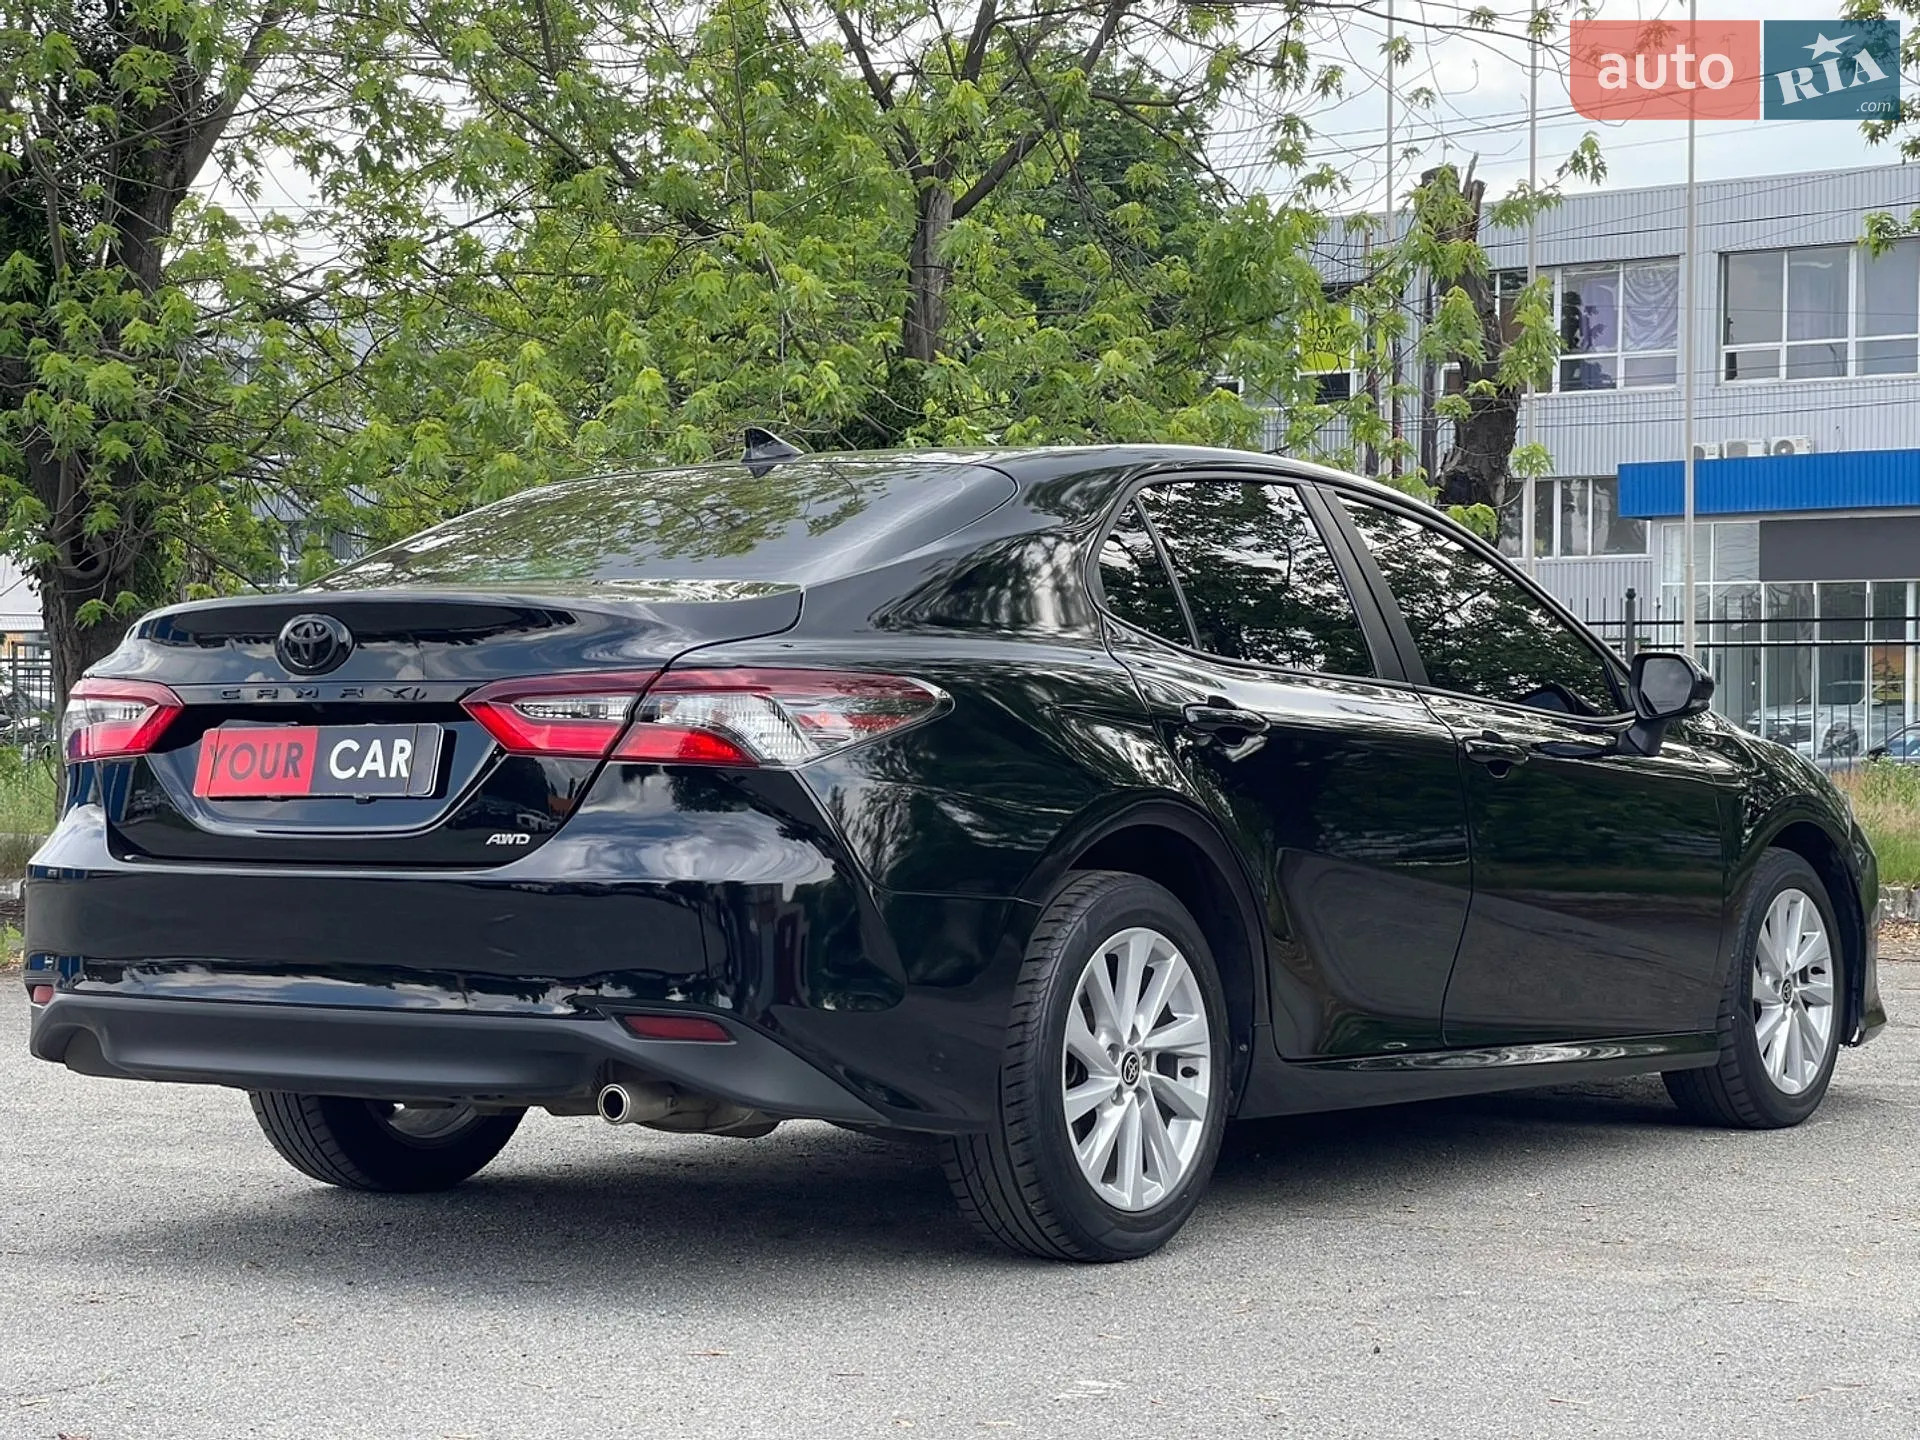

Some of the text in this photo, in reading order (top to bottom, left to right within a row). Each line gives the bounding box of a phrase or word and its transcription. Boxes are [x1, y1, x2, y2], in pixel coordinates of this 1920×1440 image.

[209, 738, 413, 780] YOUR CAR
[486, 833, 531, 845] AWD
